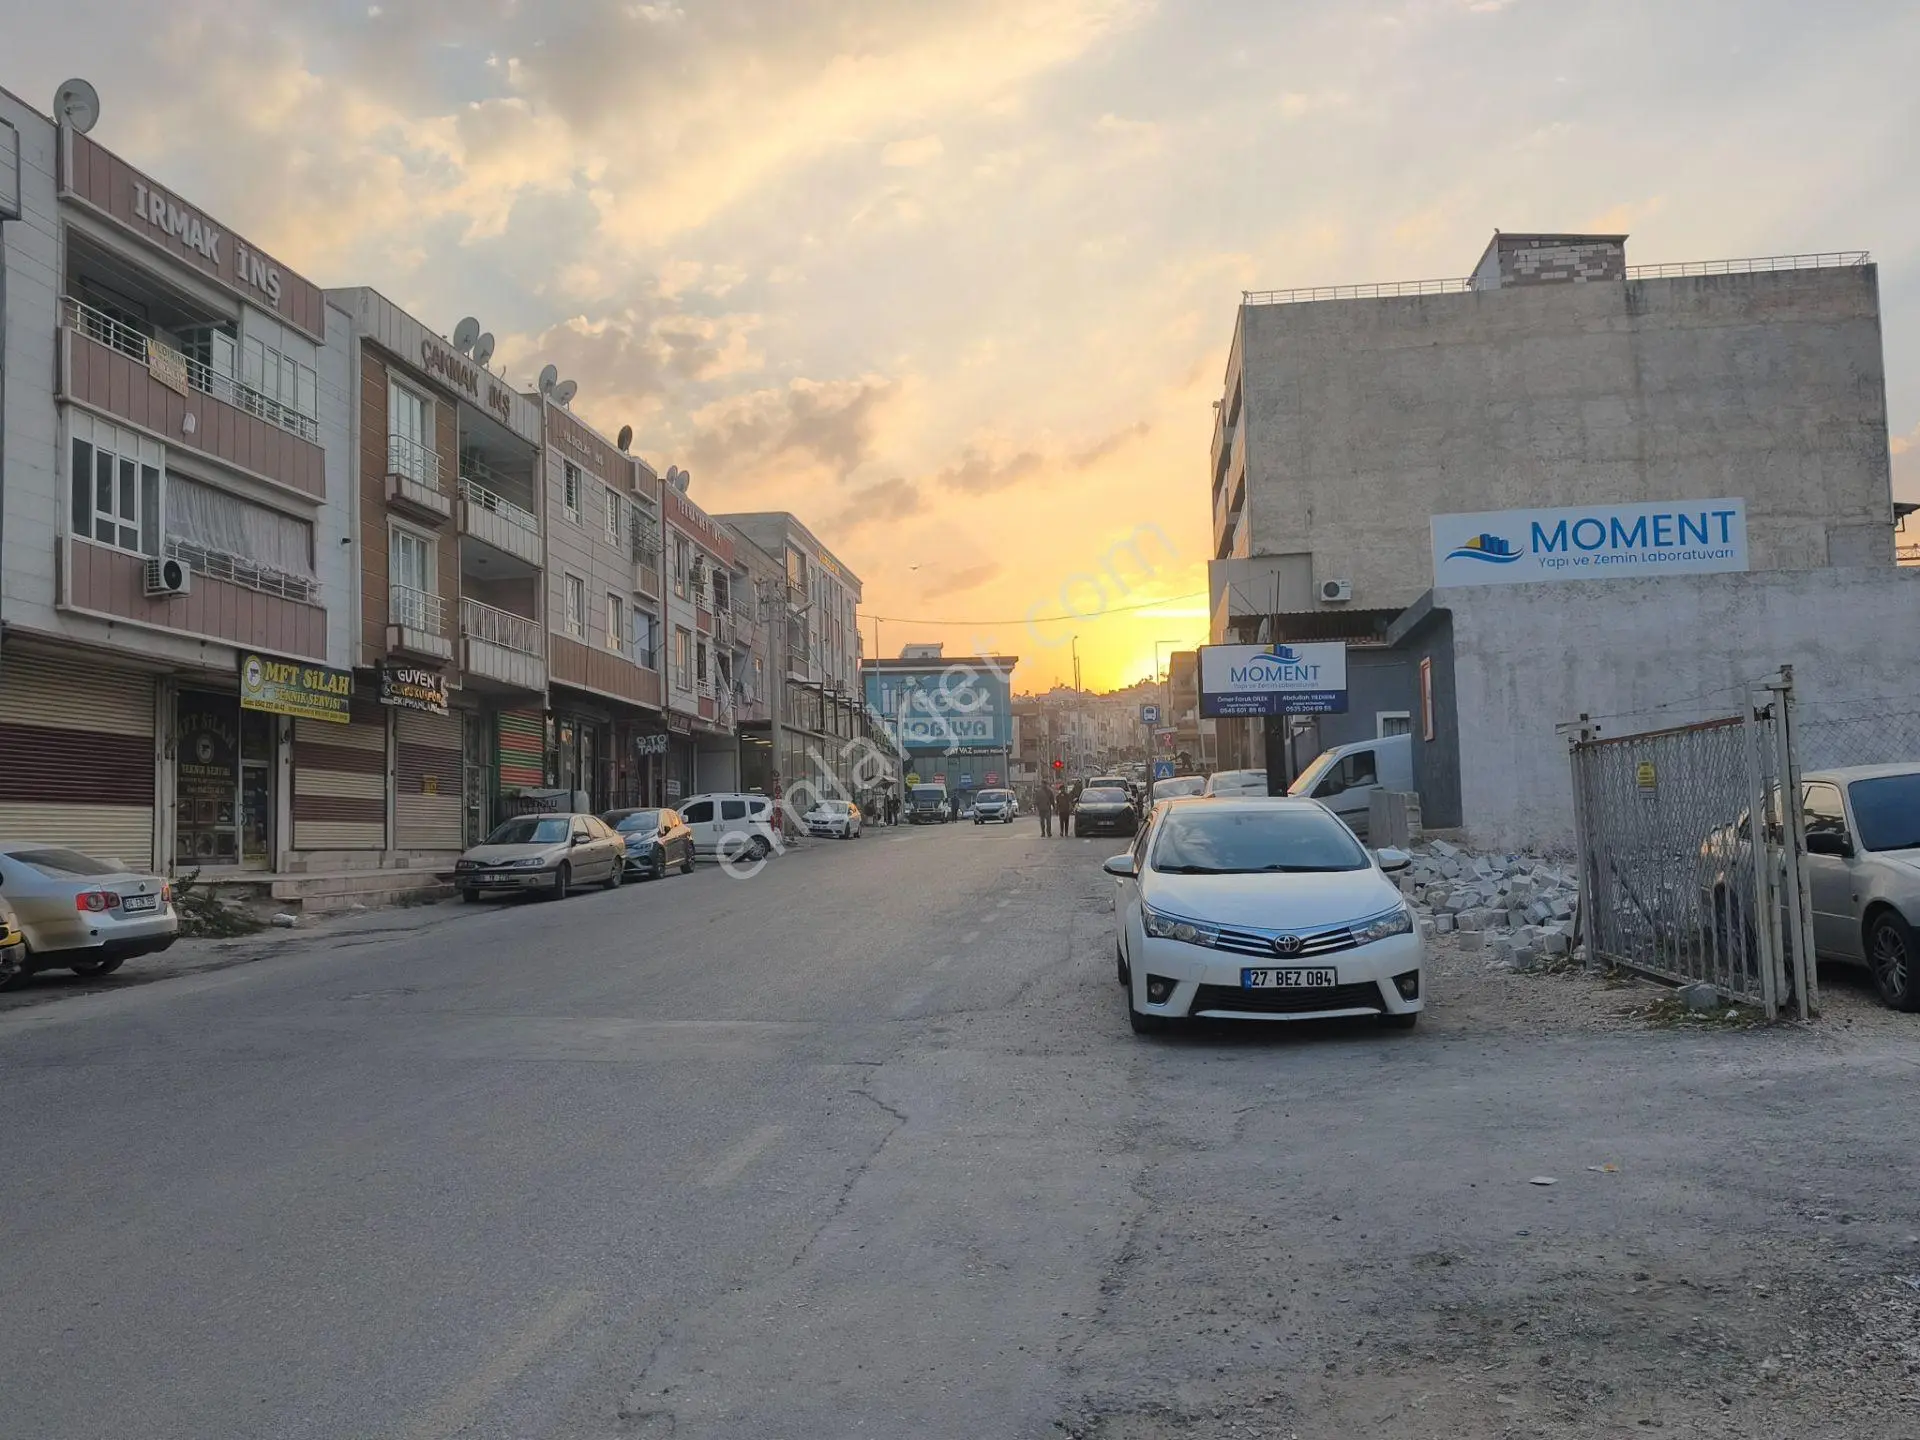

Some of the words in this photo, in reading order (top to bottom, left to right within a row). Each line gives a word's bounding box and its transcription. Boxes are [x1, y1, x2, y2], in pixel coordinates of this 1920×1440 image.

[133, 180, 220, 265] IRMAK
[237, 242, 281, 307] İNŞ
[1531, 510, 1736, 553] MOMENT
[1538, 553, 1569, 569] Yapı
[1573, 556, 1590, 566] ve
[1593, 551, 1638, 565] Zemin
[1641, 548, 1734, 563] Laboratuvarı
[265, 661, 300, 686] MFT
[1230, 665, 1321, 682] MOMENT
[636, 734, 667, 746] OTO
[1251, 970, 1268, 987] 27
[1275, 970, 1302, 987] BEZ
[1306, 970, 1332, 987] 084
